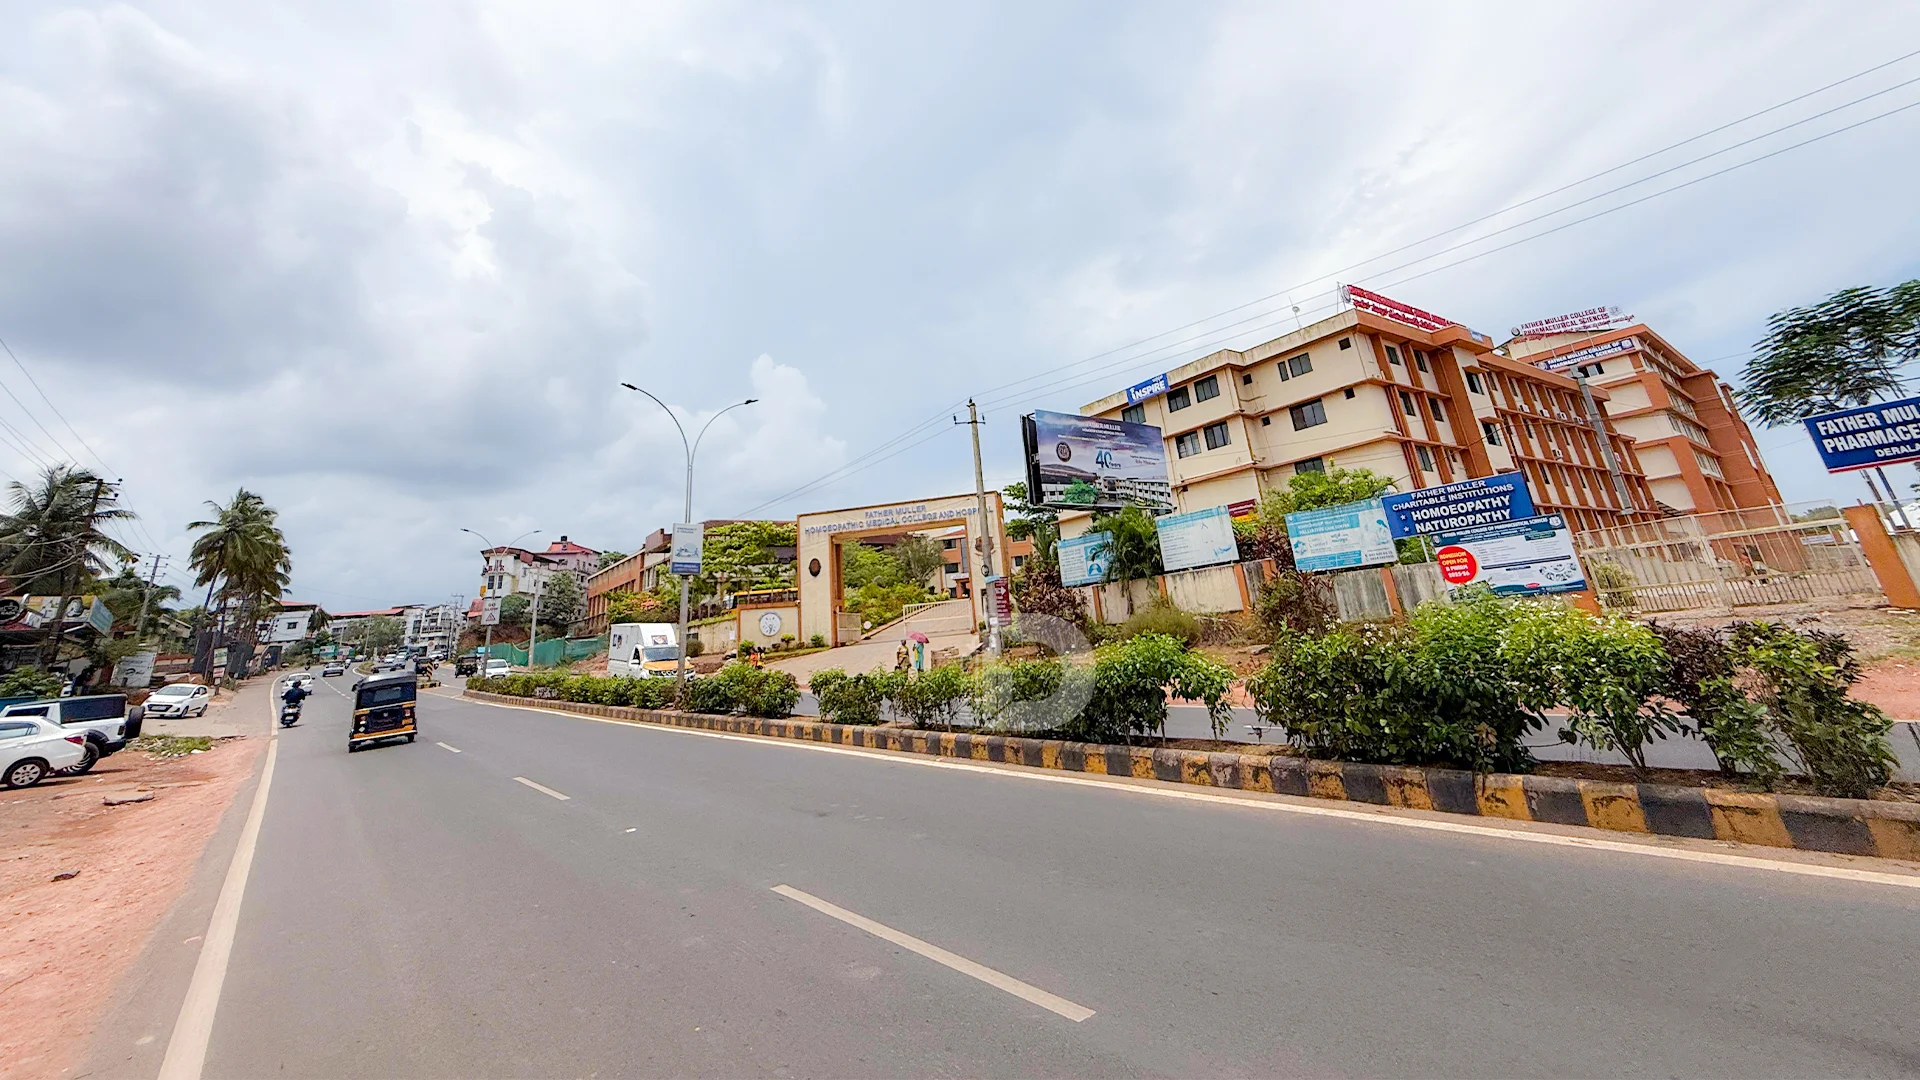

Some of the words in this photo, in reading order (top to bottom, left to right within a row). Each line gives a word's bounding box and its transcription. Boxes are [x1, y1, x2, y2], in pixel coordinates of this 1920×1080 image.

[1521, 320, 1543, 330] FATHER
[1544, 314, 1569, 325] MULLER
[1570, 307, 1597, 319] COLLEGE
[1579, 313, 1610, 324] SCIENCES
[1130, 380, 1166, 401] INSPIRE
[1815, 412, 1881, 436] FATHER
[1881, 404, 1920, 424] MUL
[1822, 423, 1920, 453] PHARMACE
[1096, 450, 1112, 468] 40
[1392, 495, 1447, 511] CHARITABLE
[1448, 483, 1514, 501] INSTITUTIONS
[1411, 486, 1446, 500] FATHER
[1447, 480, 1486, 494] MULLER
[865, 508, 893, 518] FATHER
[895, 505, 926, 515] MULLER
[1411, 495, 1510, 521] HOMOEOPATHY
[805, 521, 864, 534] HOMOEOPATHIC
[866, 518, 900, 527] MEDICAL
[902, 512, 937, 523] COLLEGE
[938, 510, 954, 519] AND
[955, 506, 993, 517] HOSPIL
[1415, 509, 1511, 533] NATUROPATHY
